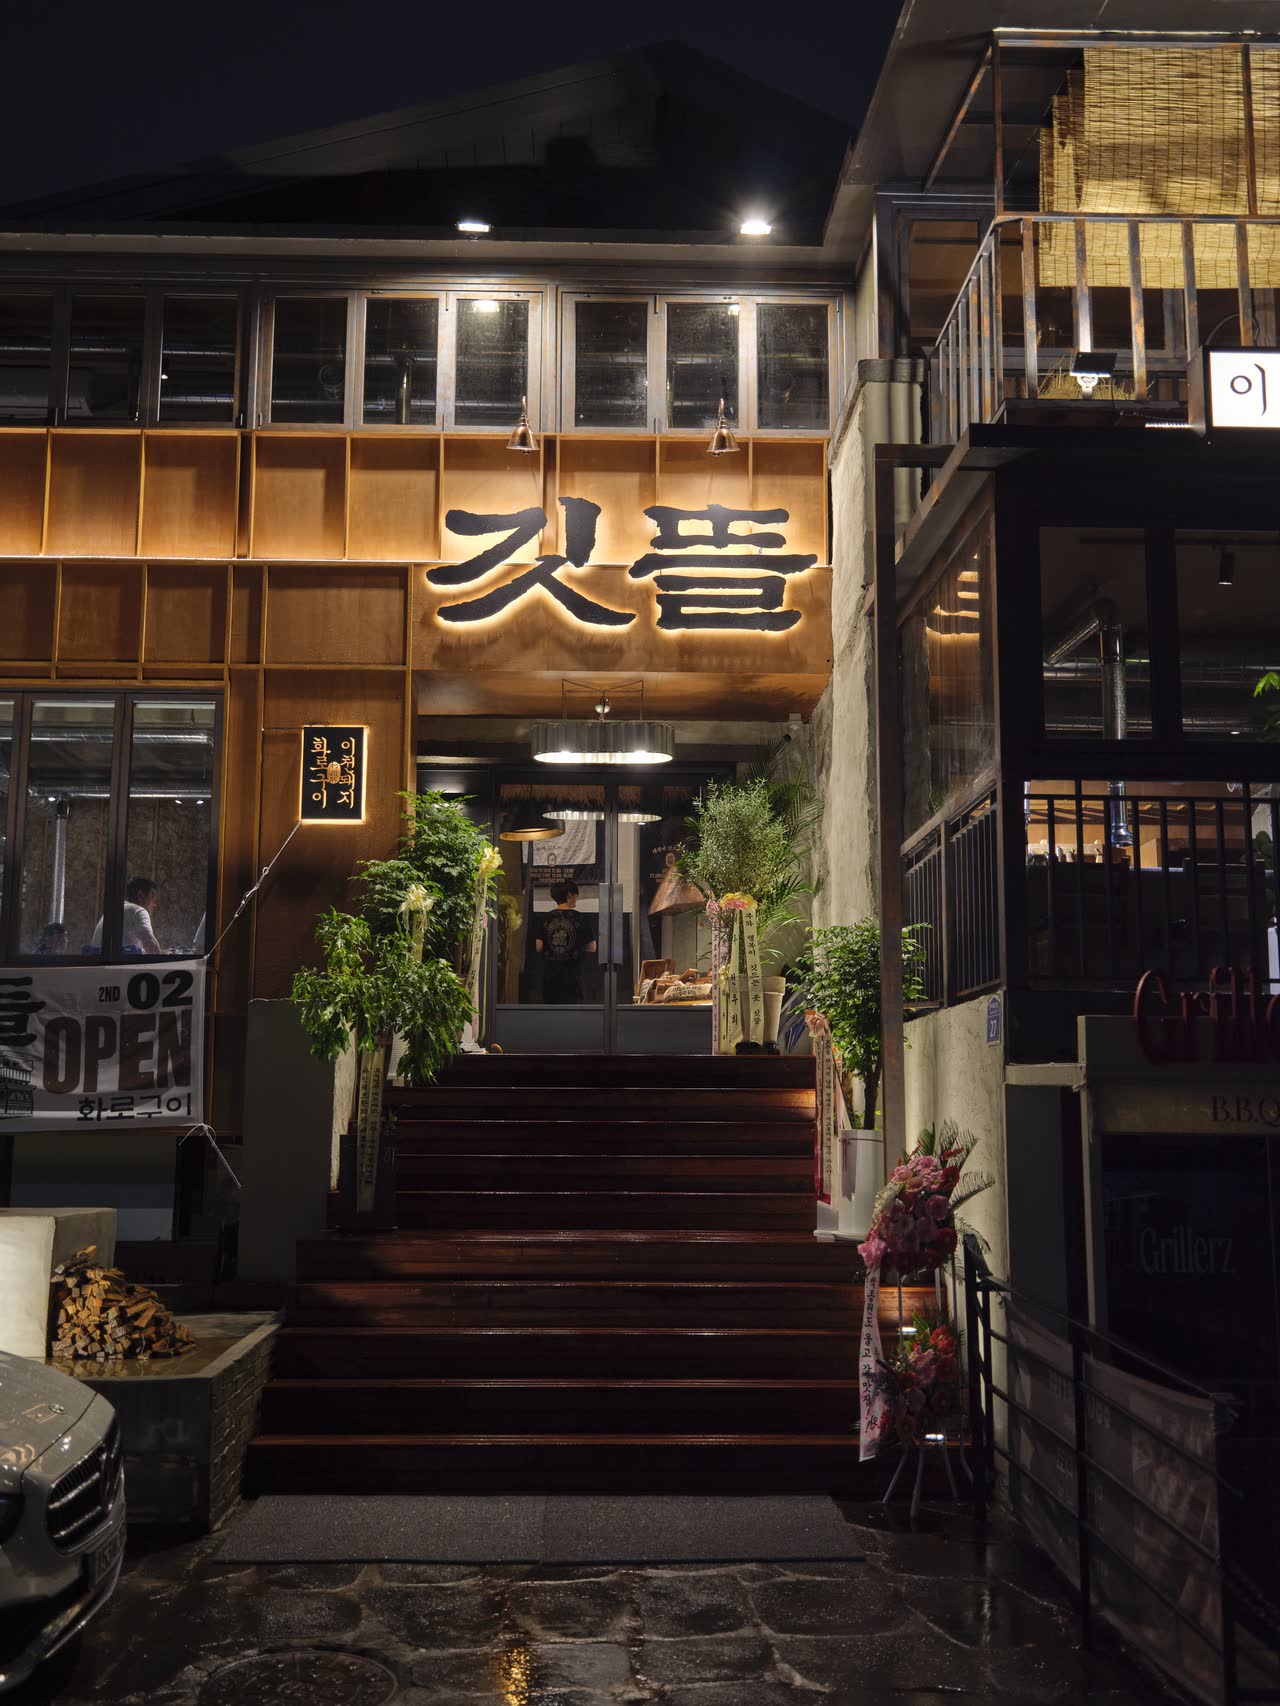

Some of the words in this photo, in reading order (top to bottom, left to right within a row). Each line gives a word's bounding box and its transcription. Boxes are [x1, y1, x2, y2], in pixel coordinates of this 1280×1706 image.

[310, 736, 331, 809] 화로구이
[99, 986, 120, 1002] 2ND
[127, 969, 194, 1010] 02
[43, 1009, 193, 1095] OPEN
[77, 1092, 191, 1122] 화로구이
